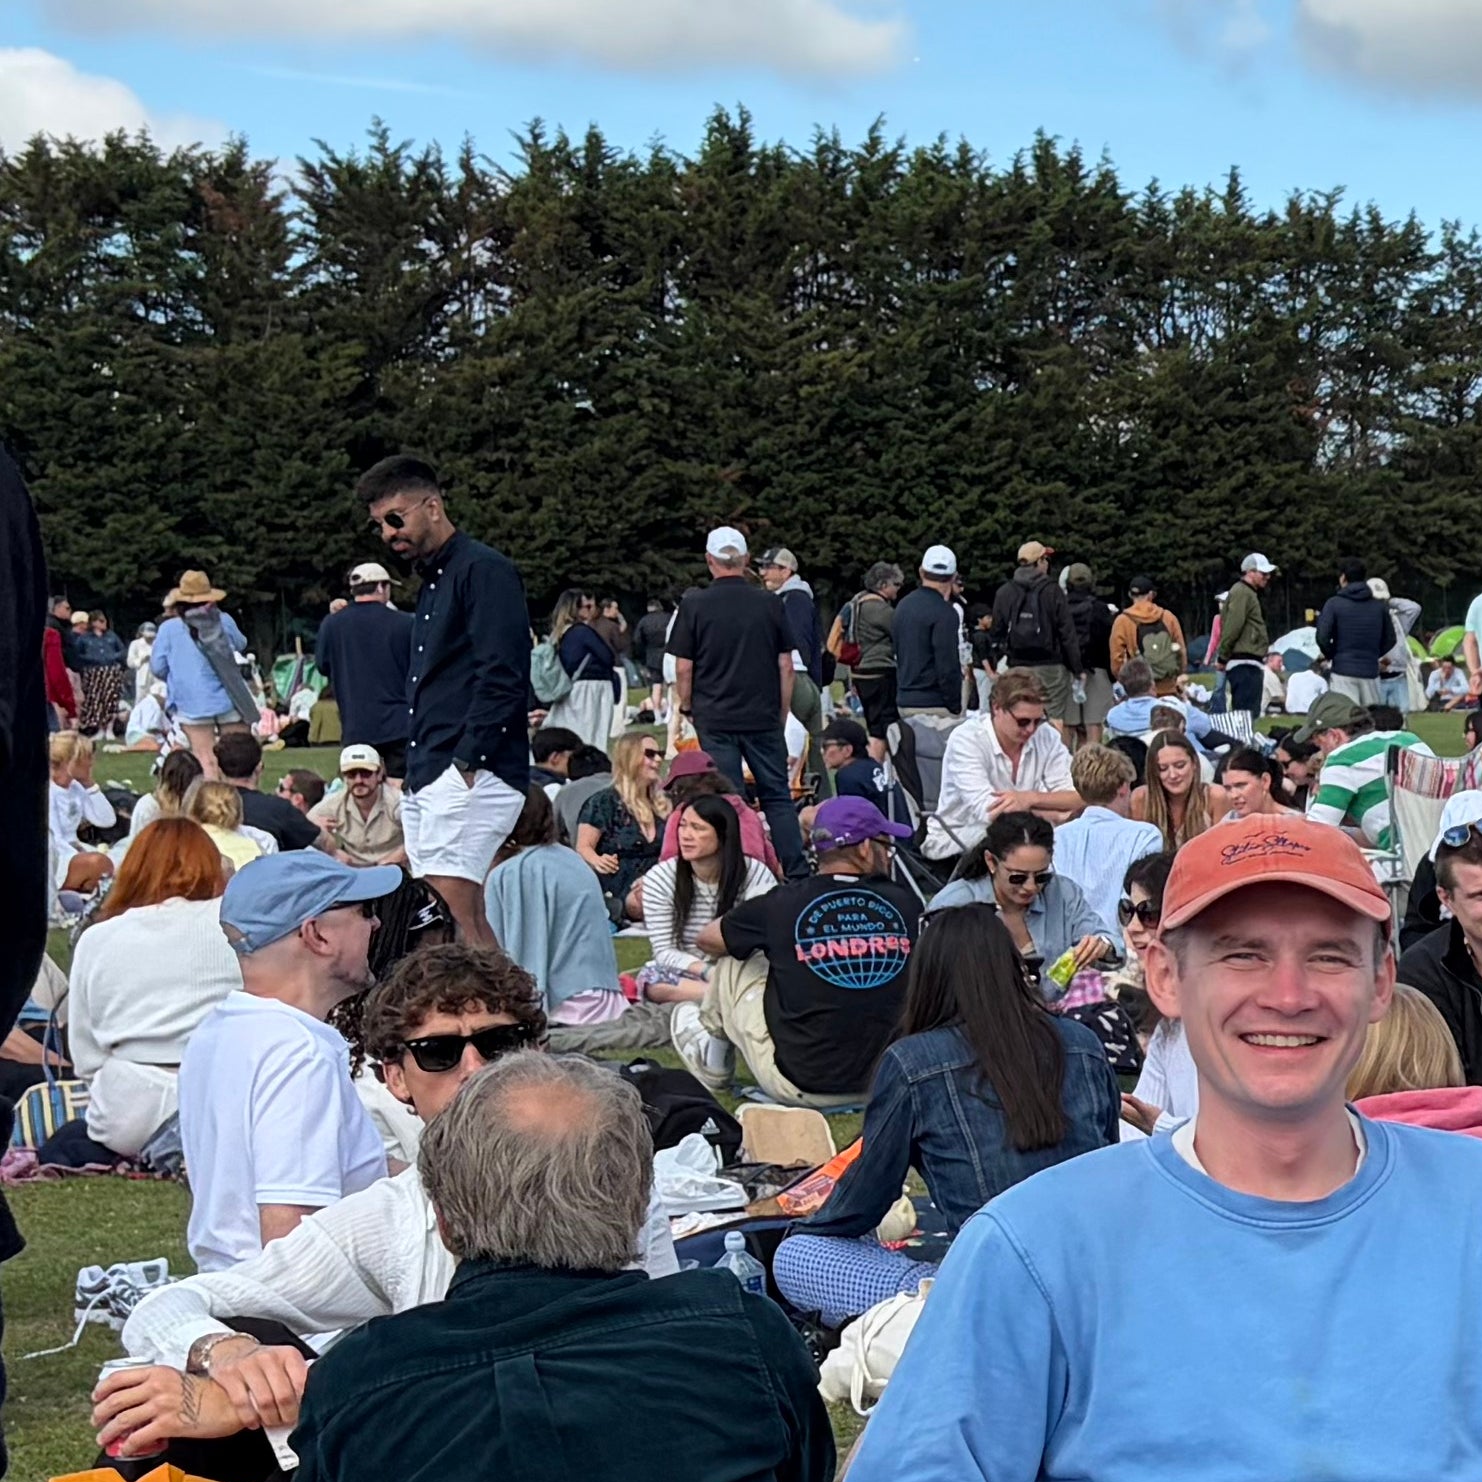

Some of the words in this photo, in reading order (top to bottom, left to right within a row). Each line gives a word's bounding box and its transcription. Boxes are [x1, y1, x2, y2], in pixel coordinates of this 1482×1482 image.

[821, 896, 866, 912] PUERTO
[867, 900, 894, 920] RICO
[837, 913, 868, 921] PARA
[823, 924, 838, 933] EL
[841, 921, 885, 931] MUNDO
[795, 935, 910, 961] LONDRES
